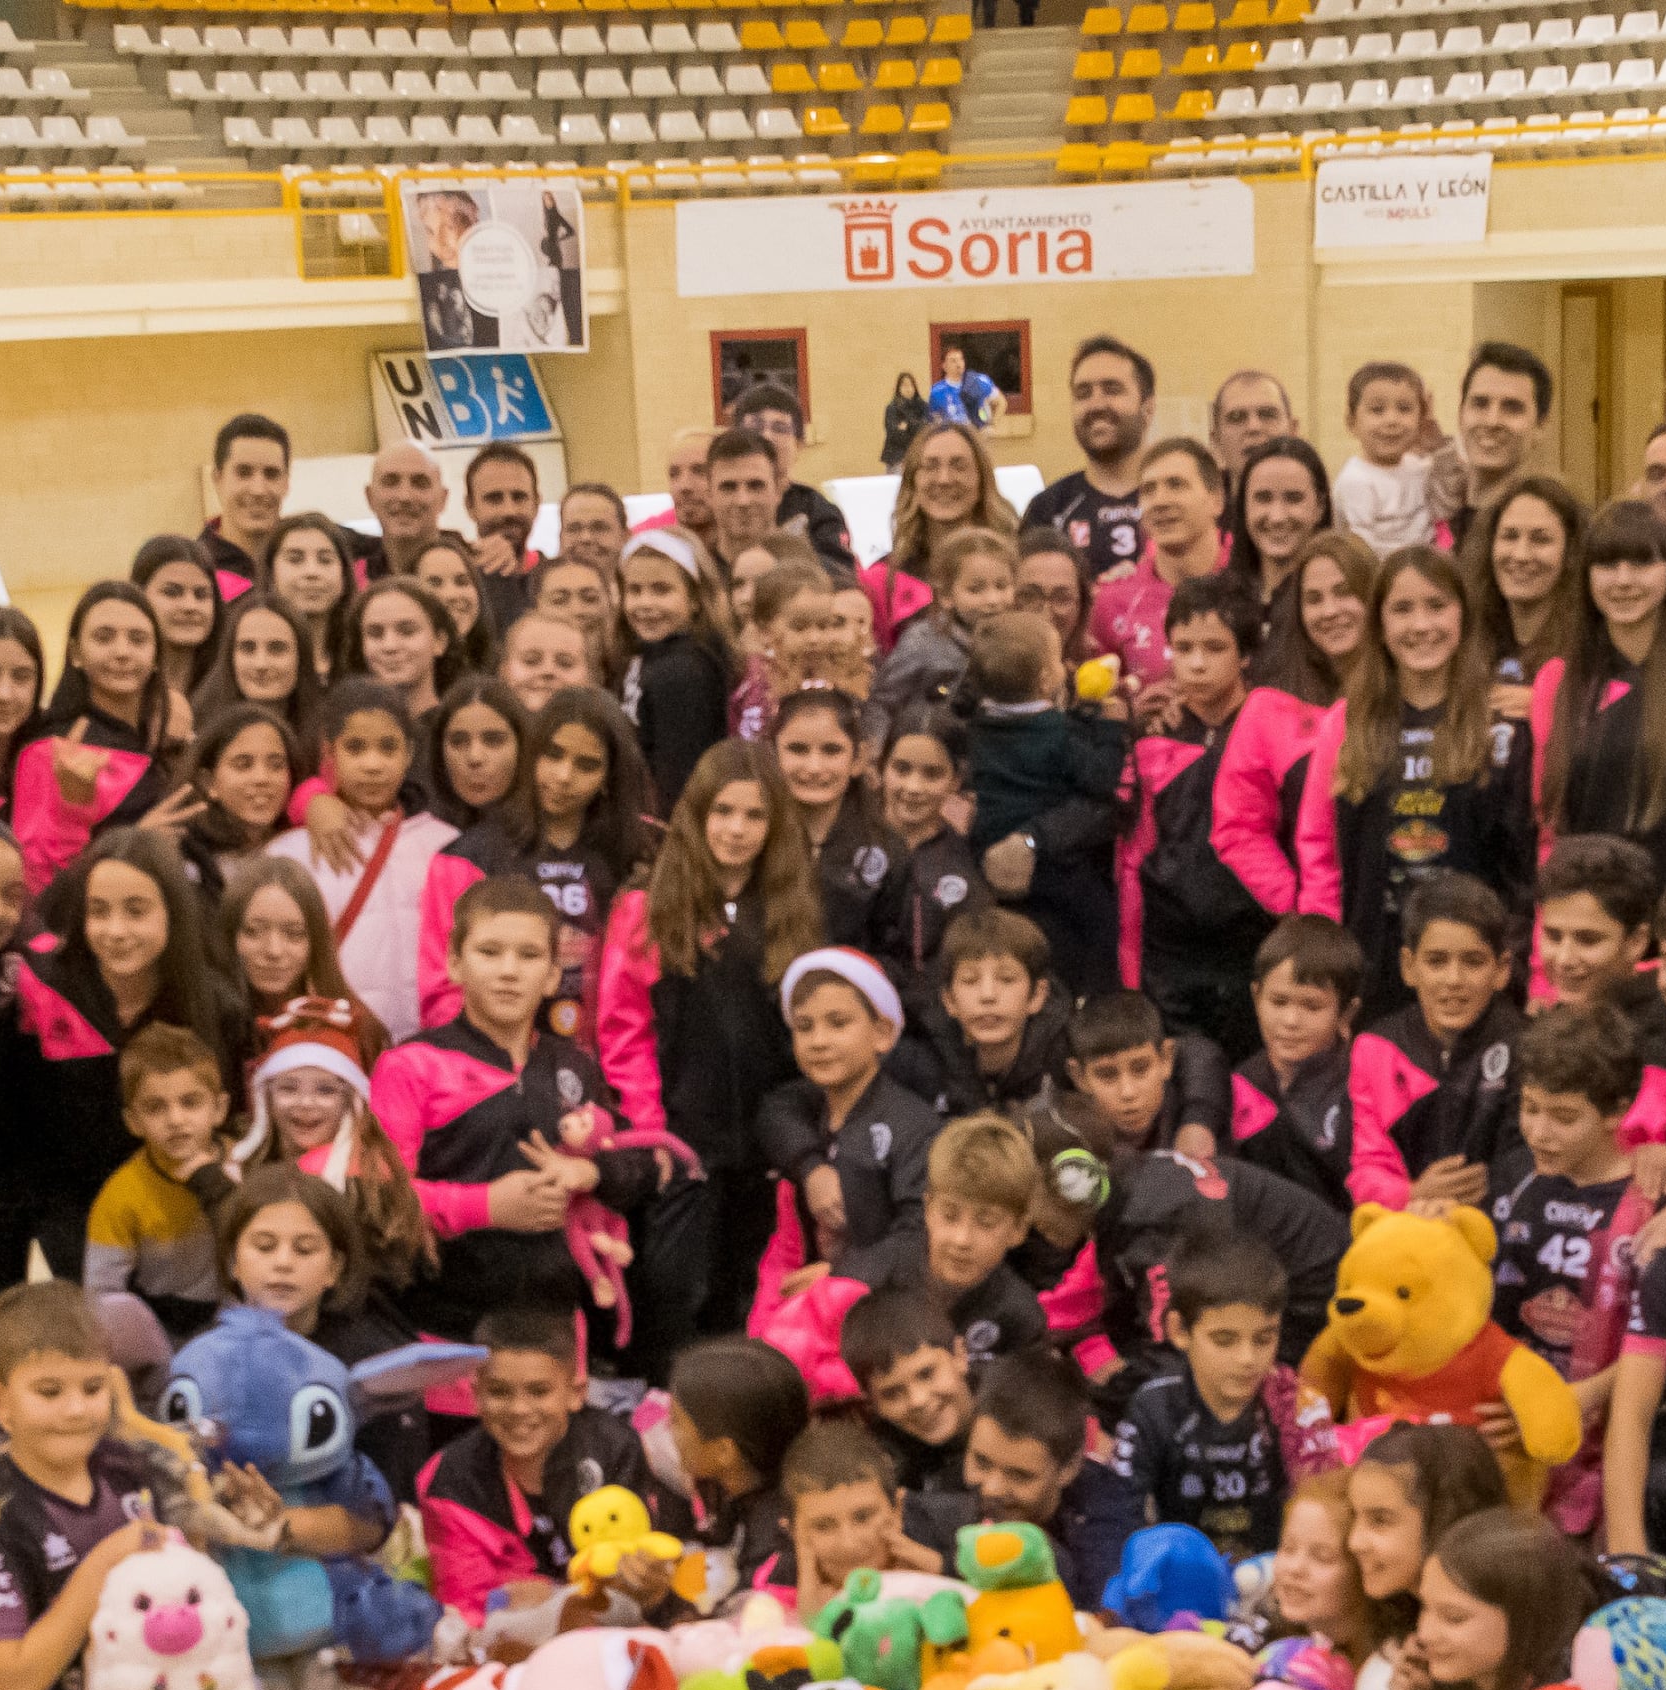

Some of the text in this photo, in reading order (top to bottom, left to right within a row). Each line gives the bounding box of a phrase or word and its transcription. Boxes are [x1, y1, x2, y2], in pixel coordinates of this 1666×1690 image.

[1321, 173, 1486, 203] CASTILLA Y LEÓN
[960, 214, 1092, 231] AYUNTAMIENTO
[907, 217, 1092, 280] Soria
[1110, 524, 1136, 556] 3
[1536, 1232, 1593, 1279] 42
